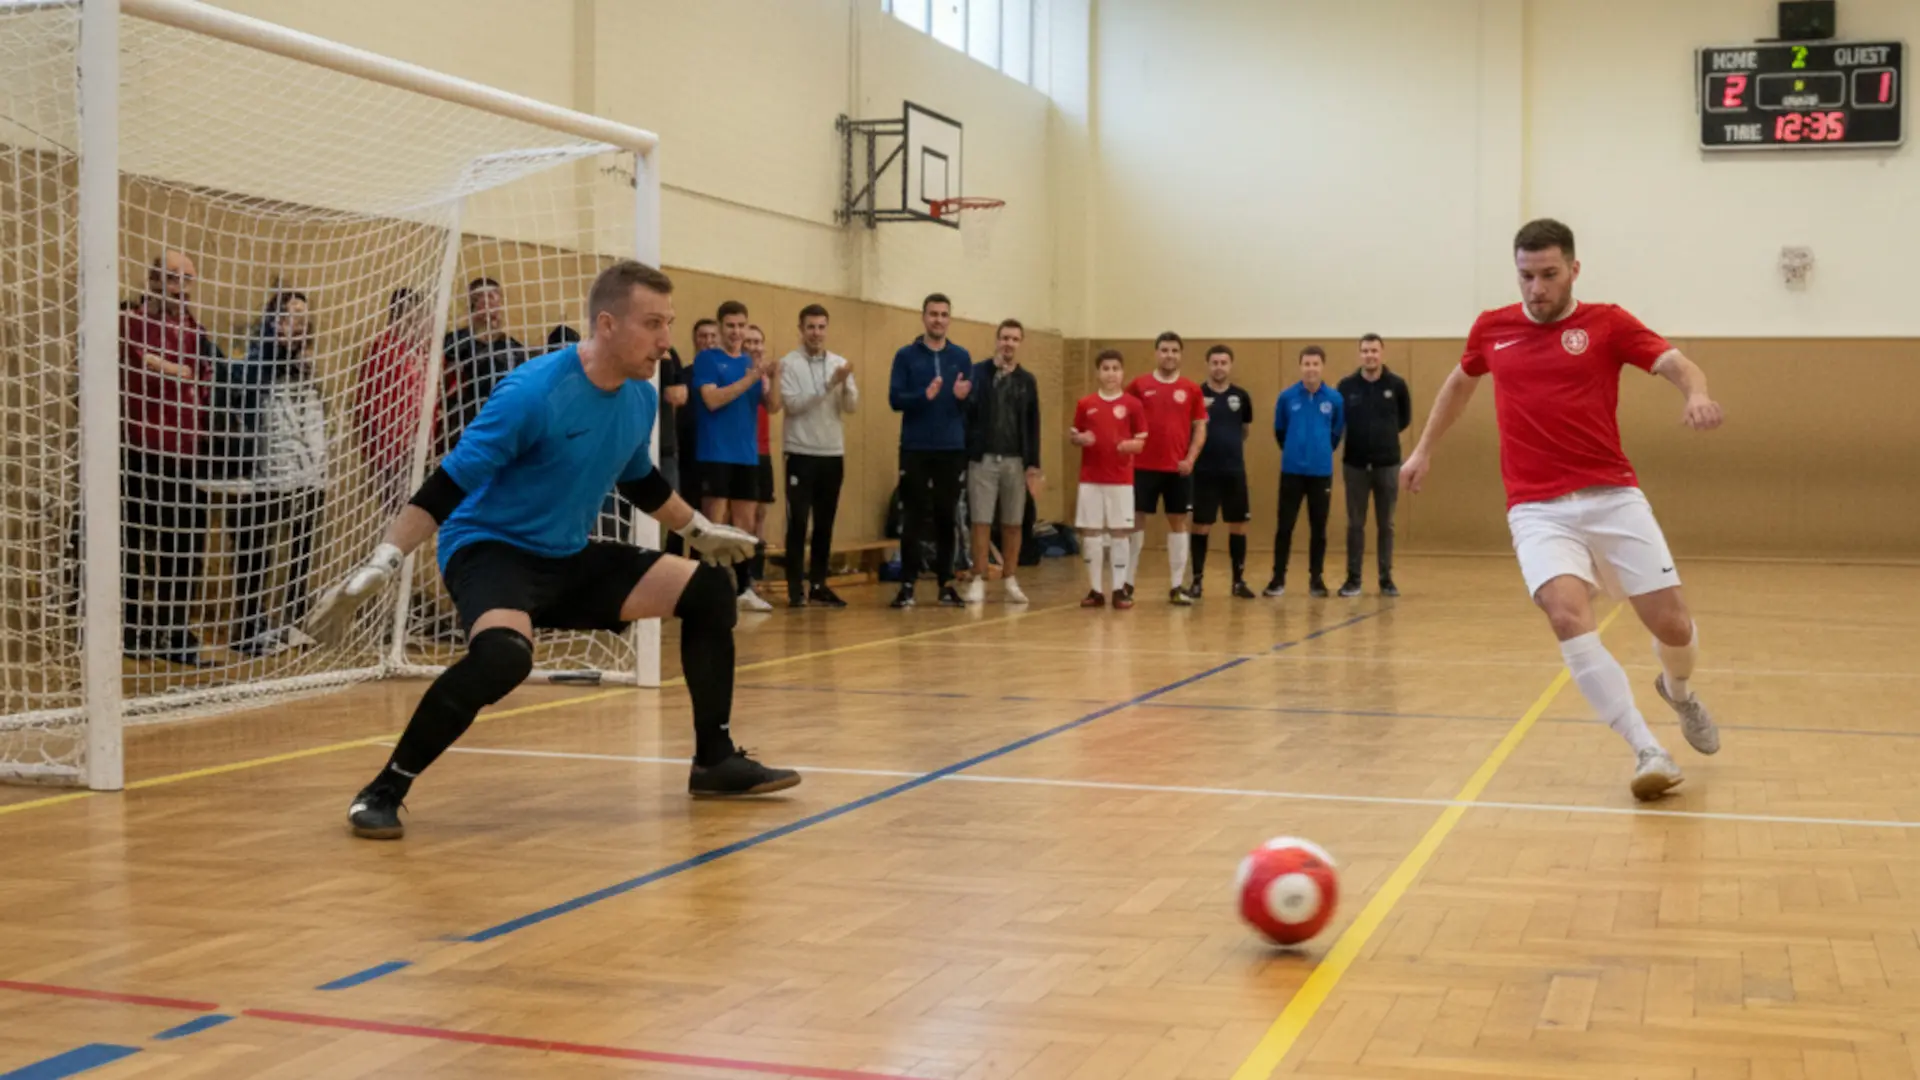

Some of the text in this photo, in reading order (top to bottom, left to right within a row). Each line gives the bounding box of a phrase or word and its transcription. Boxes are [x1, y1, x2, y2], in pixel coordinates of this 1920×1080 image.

[1791, 46, 1808, 68] 2
[1723, 75, 1747, 107] 2
[1878, 72, 1891, 102] 1
[1774, 112, 1845, 141] 12:35
